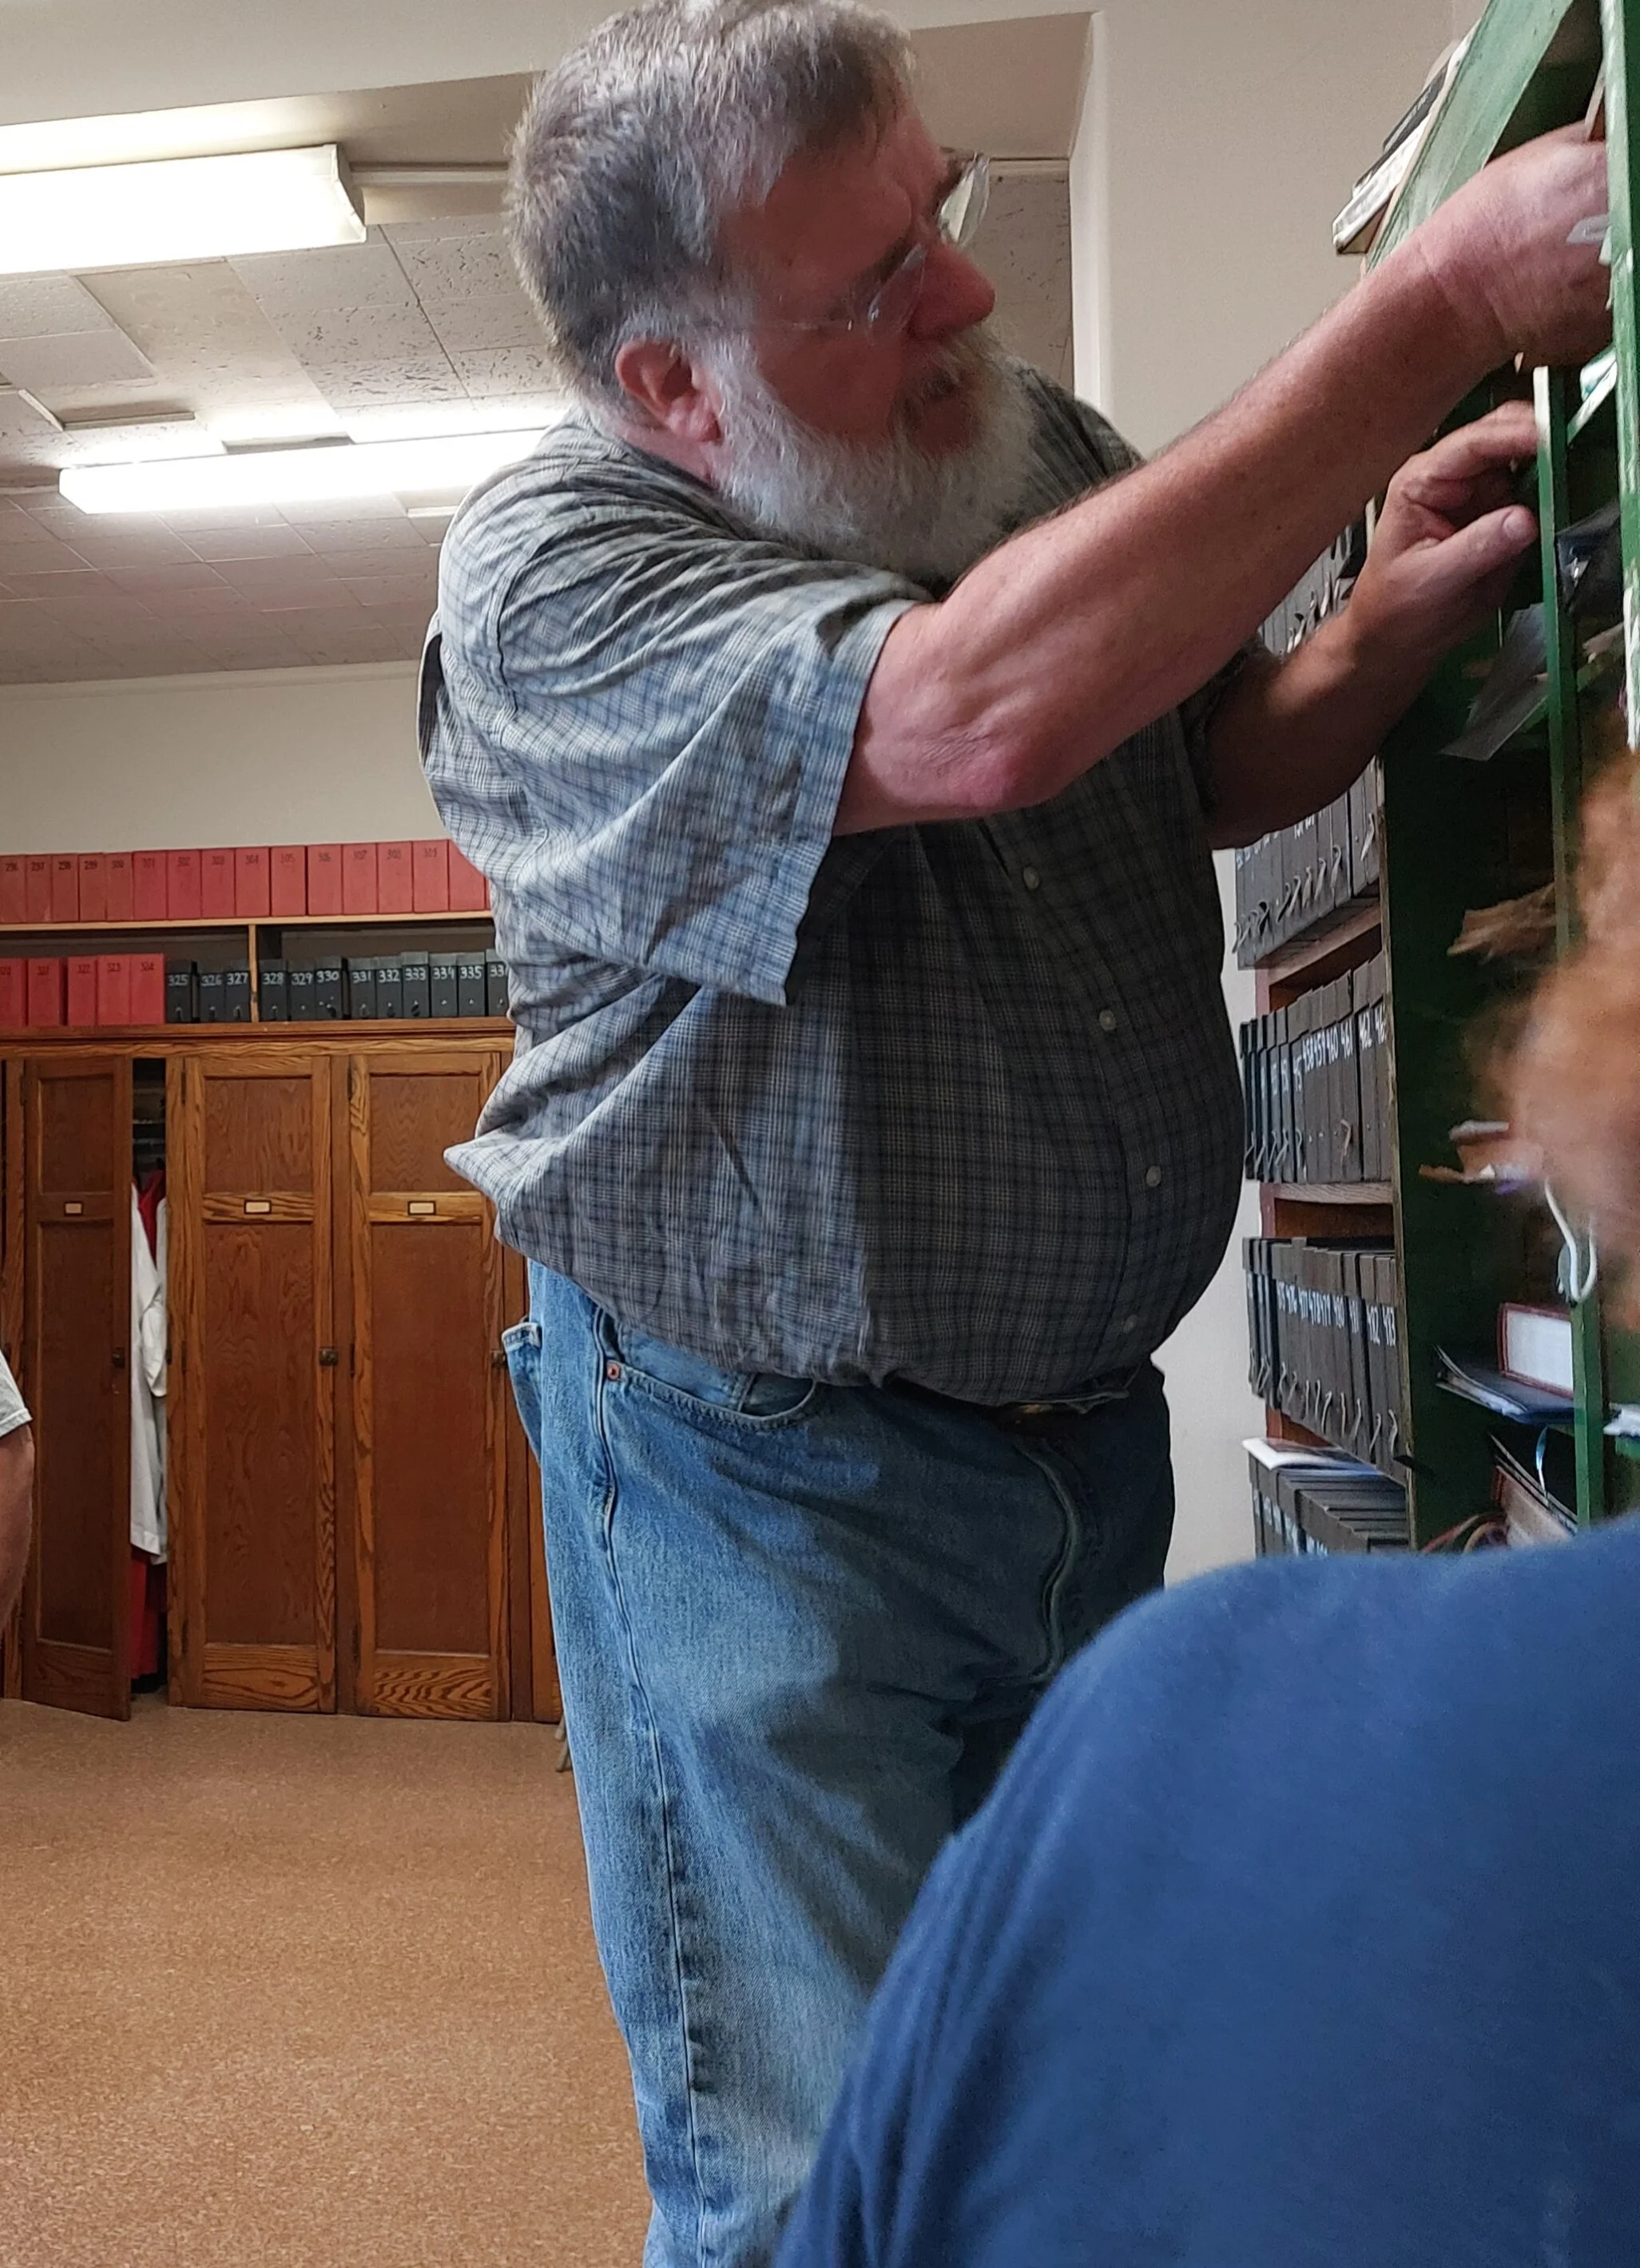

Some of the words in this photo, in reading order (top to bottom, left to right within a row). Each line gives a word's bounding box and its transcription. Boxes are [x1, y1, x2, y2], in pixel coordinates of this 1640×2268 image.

[354, 850, 368, 861] 307
[31, 862, 45, 871] 297
[106, 962, 121, 973] 323
[405, 967, 427, 981] 333
[432, 966, 455, 981] 334
[459, 965, 484, 980] 335
[490, 964, 508, 978] 33
[169, 973, 189, 987] 325
[201, 973, 223, 987] 326
[226, 972, 248, 986] 327
[263, 972, 284, 986] 328
[291, 972, 313, 986] 329
[316, 969, 340, 983] 330
[352, 970, 372, 984] 331
[379, 968, 401, 984] 332
[1326, 1026, 1339, 1065] 460
[1340, 1017, 1353, 1060] 461
[1313, 1030, 1326, 1069] 459
[1366, 1303, 1381, 1346] 482
[1382, 1303, 1396, 1347] 483
